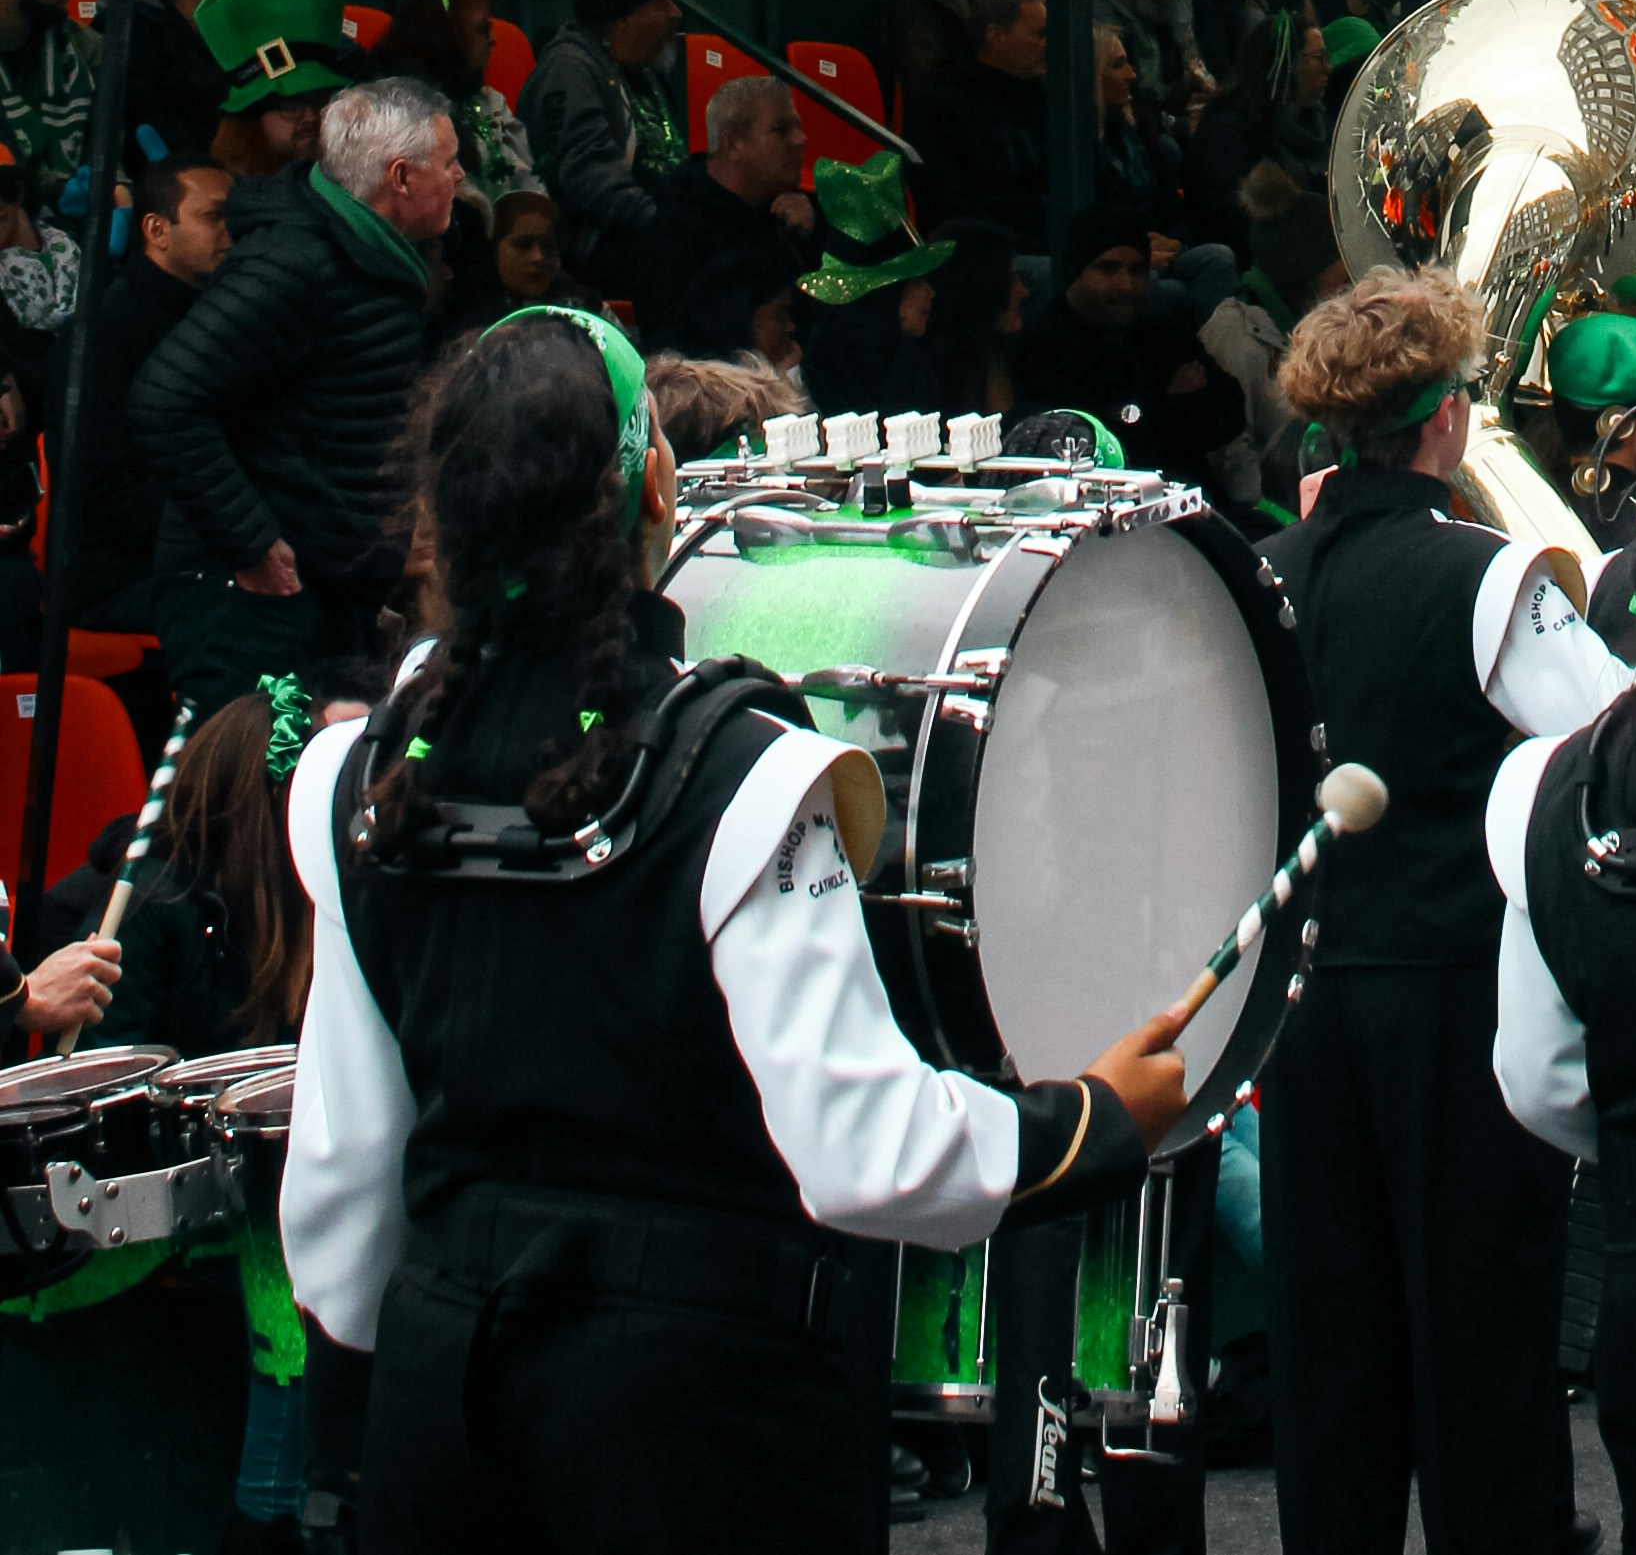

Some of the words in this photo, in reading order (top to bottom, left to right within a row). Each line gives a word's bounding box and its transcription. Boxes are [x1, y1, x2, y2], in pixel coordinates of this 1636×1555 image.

[1531, 584, 1546, 634] BISHOP
[778, 821, 806, 894] BISHOP
[1035, 1375, 1067, 1508] Pearl
